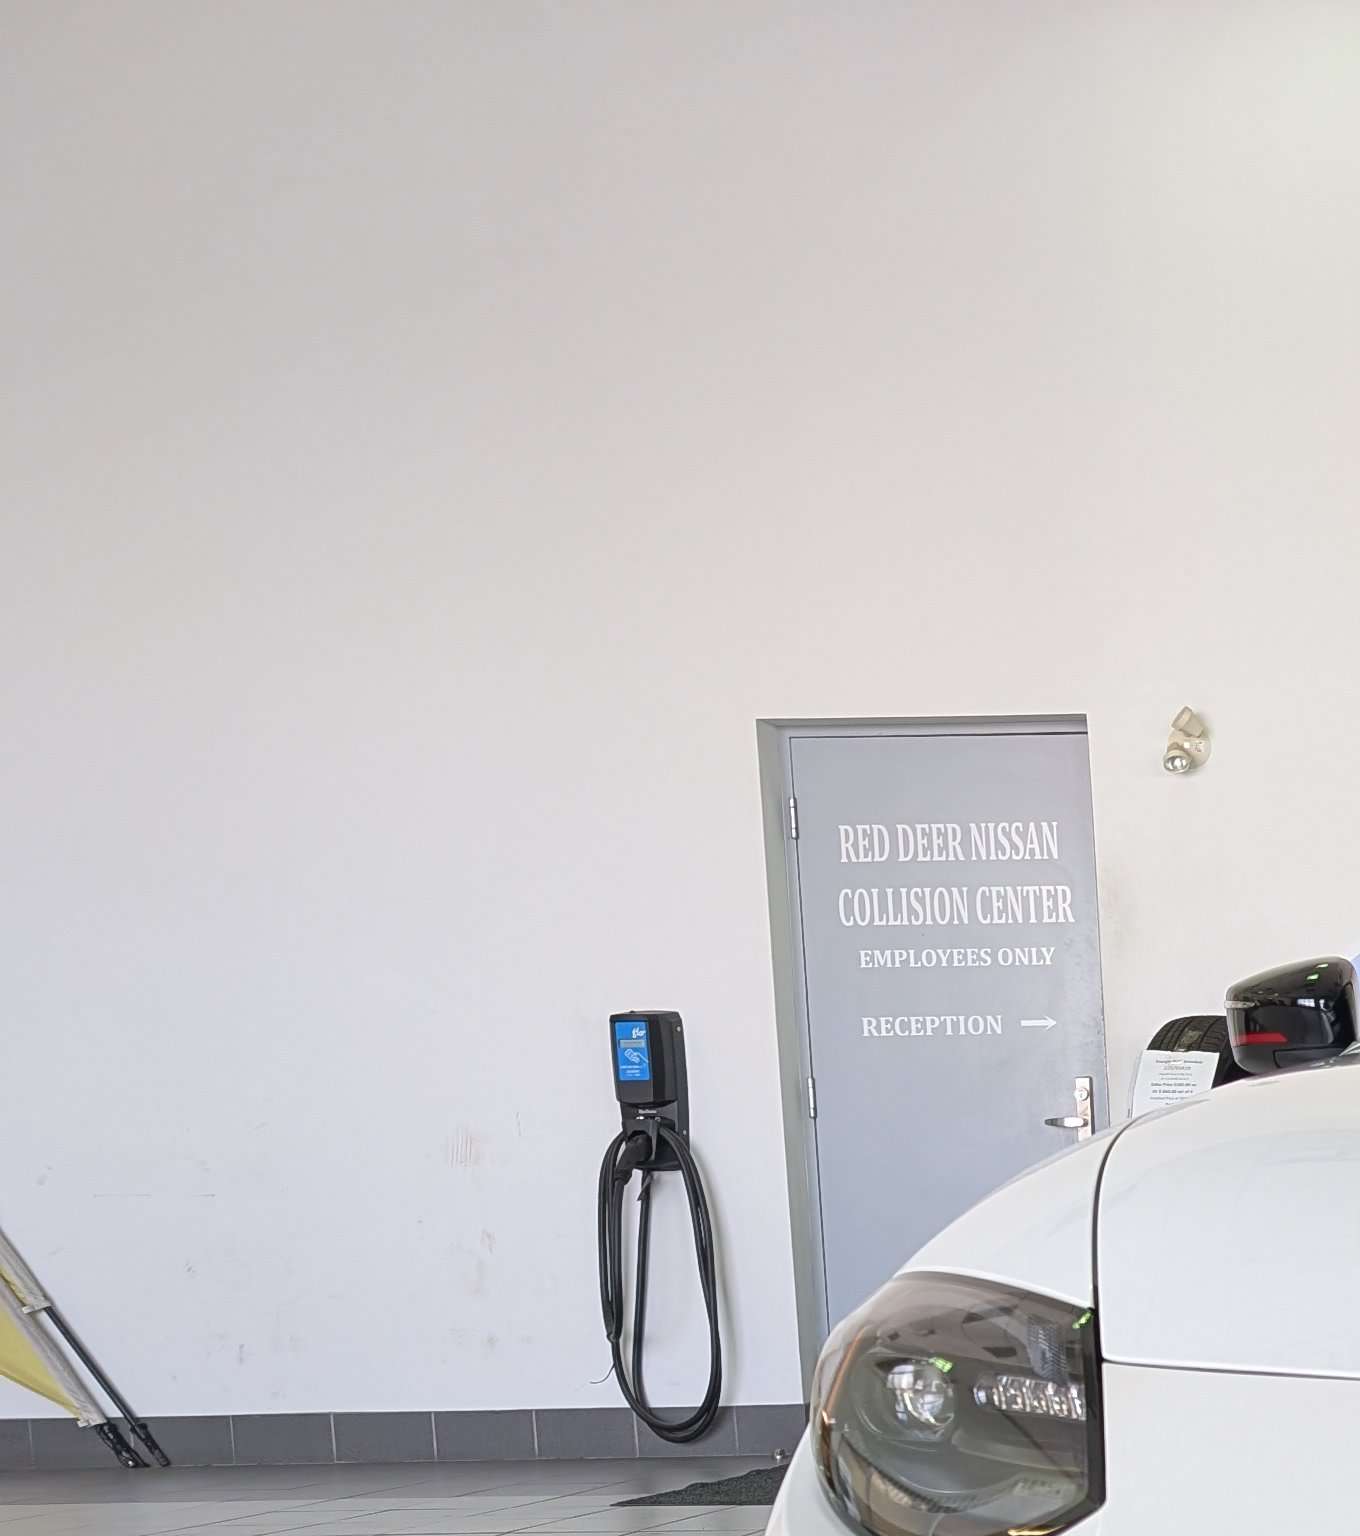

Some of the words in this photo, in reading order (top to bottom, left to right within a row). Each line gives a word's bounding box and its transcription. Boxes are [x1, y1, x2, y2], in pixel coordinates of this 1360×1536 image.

[838, 824, 890, 863] RED
[896, 823, 965, 862] DEER
[969, 821, 1060, 861] NISSAN
[838, 887, 969, 927] COLLISION
[975, 885, 1076, 924] CENTER
[859, 947, 993, 969] EMPLOYEES
[997, 946, 1057, 967] ONLY
[861, 1014, 1004, 1037] RECEPTION
